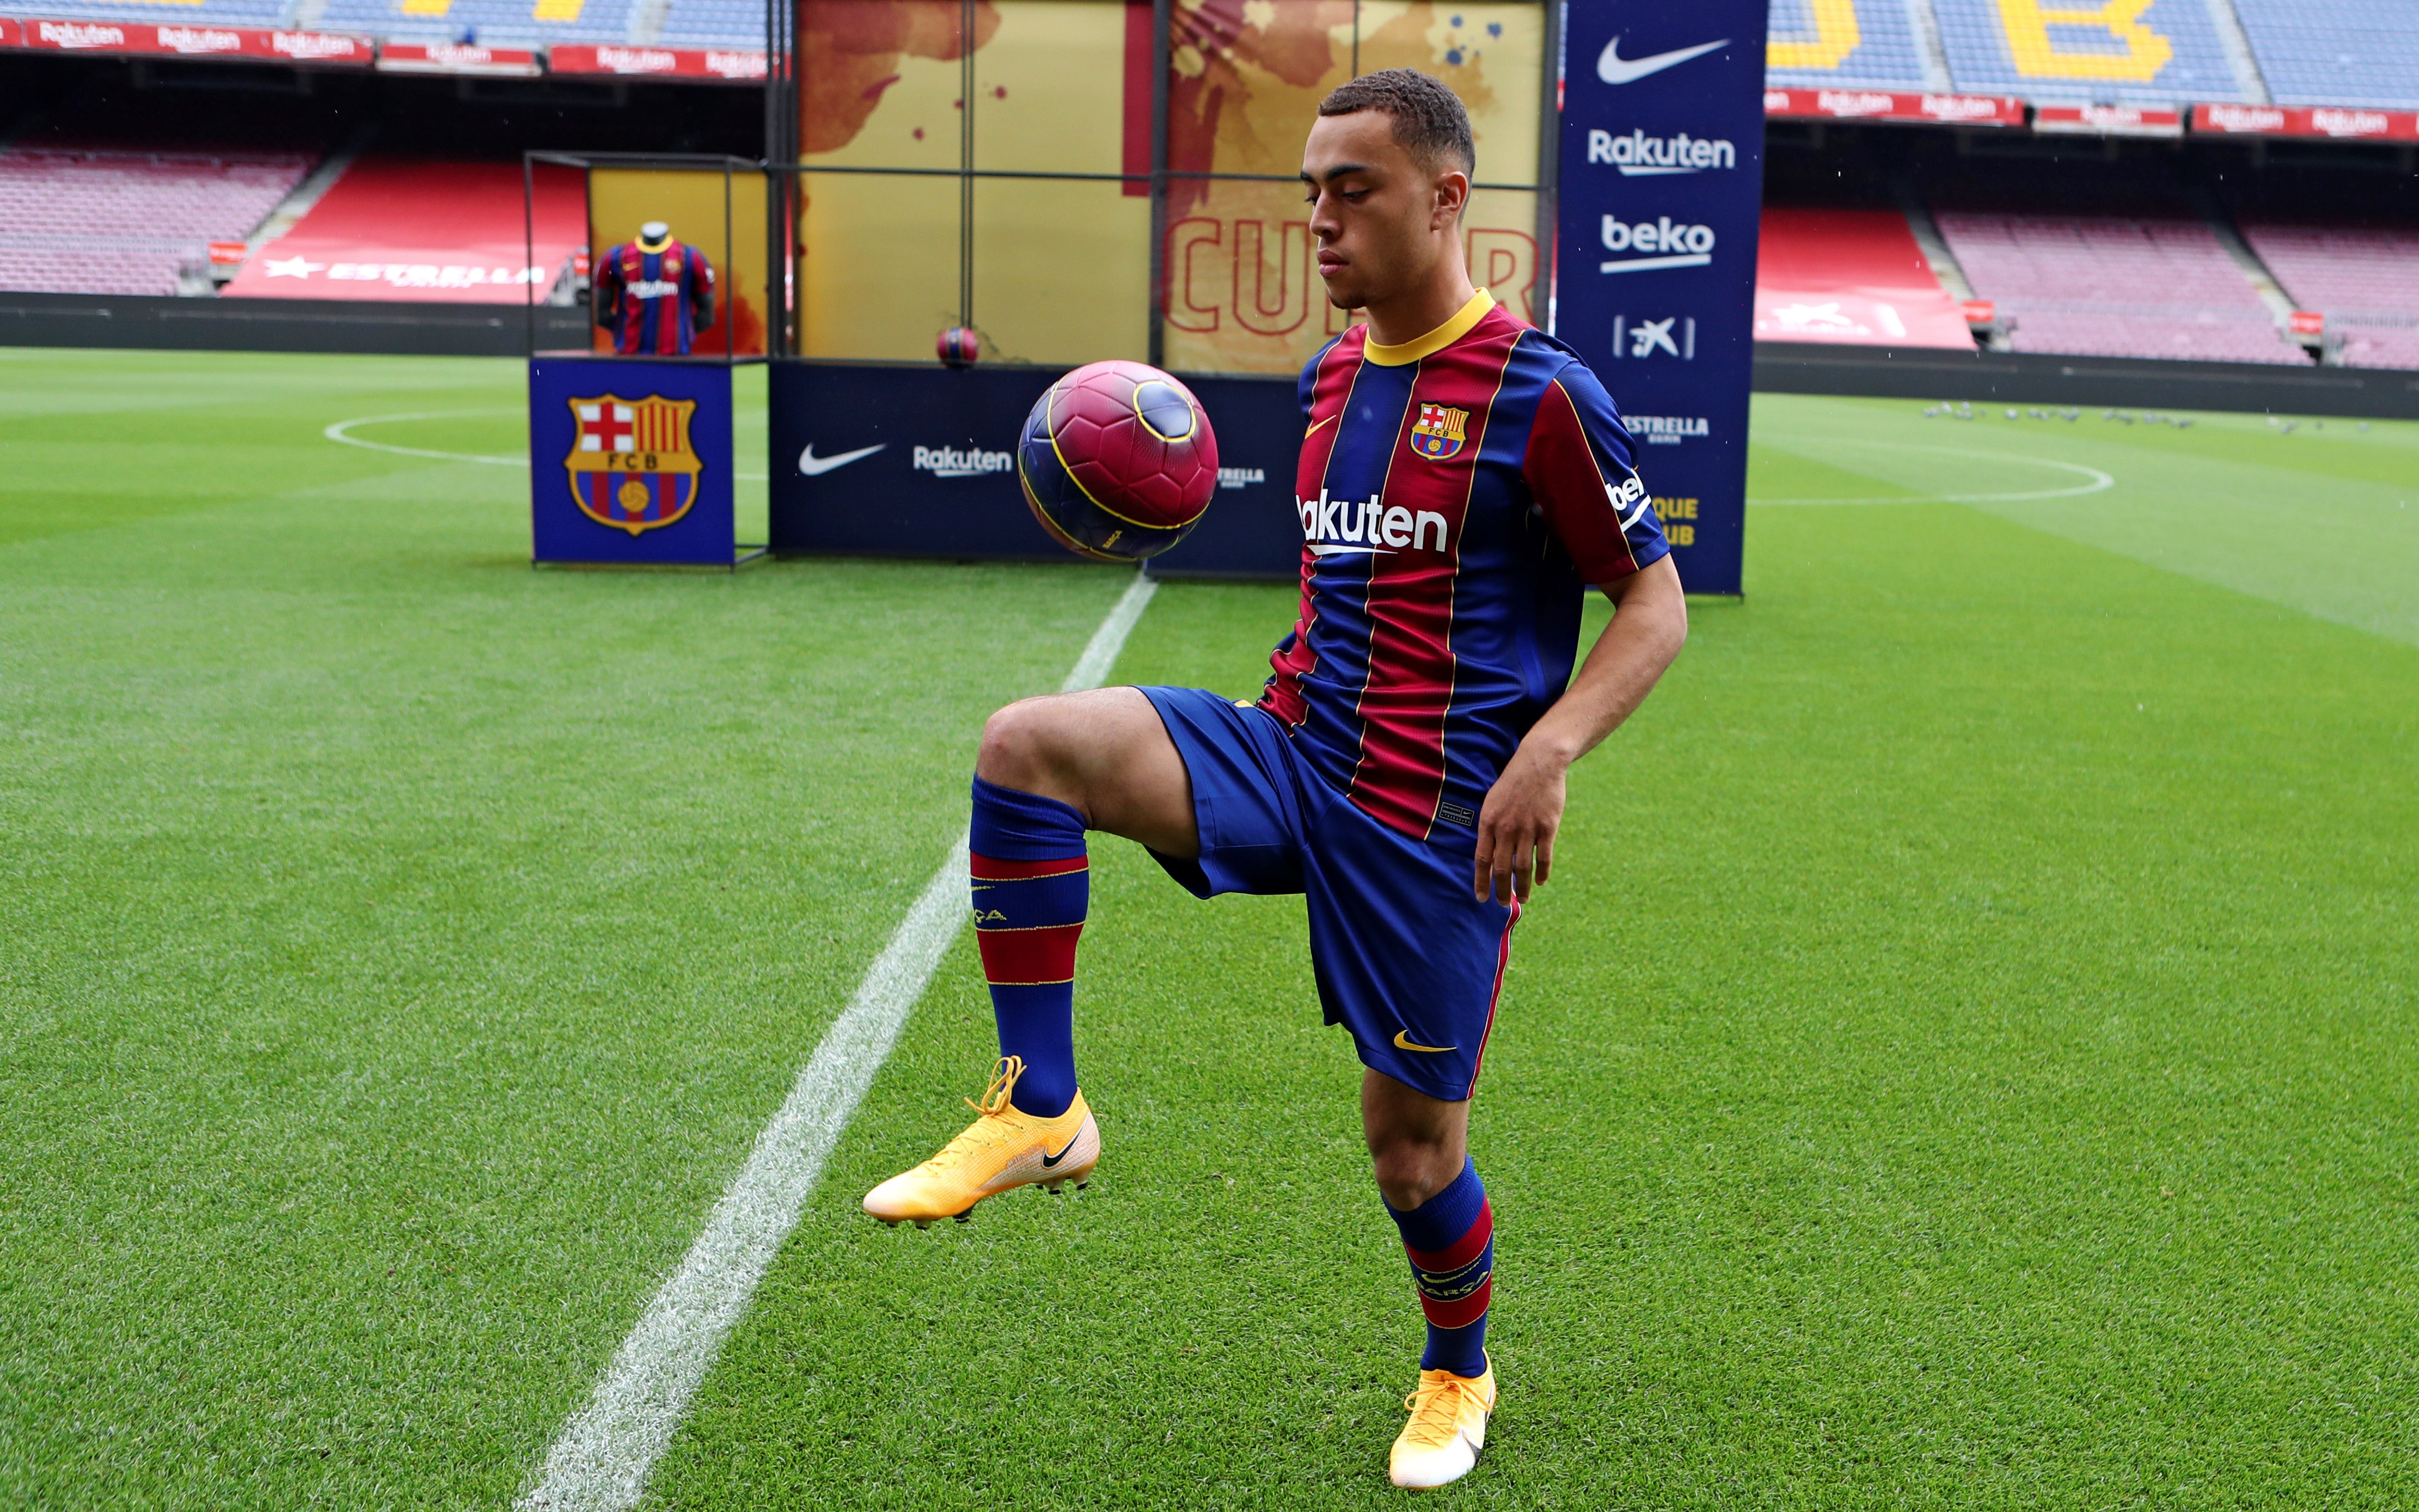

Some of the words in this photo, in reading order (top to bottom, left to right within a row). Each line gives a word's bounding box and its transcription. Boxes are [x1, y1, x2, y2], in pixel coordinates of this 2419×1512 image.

[39, 21, 125, 45] Rakuten
[157, 27, 241, 51] Rakuten
[1588, 128, 1736, 169] Rakuten
[1601, 214, 1716, 253] beko
[1622, 415, 1709, 436] ESTRELLA
[608, 453, 658, 470] FCB
[914, 445, 1012, 472] Rakuten
[1652, 497, 1698, 522] QUE
